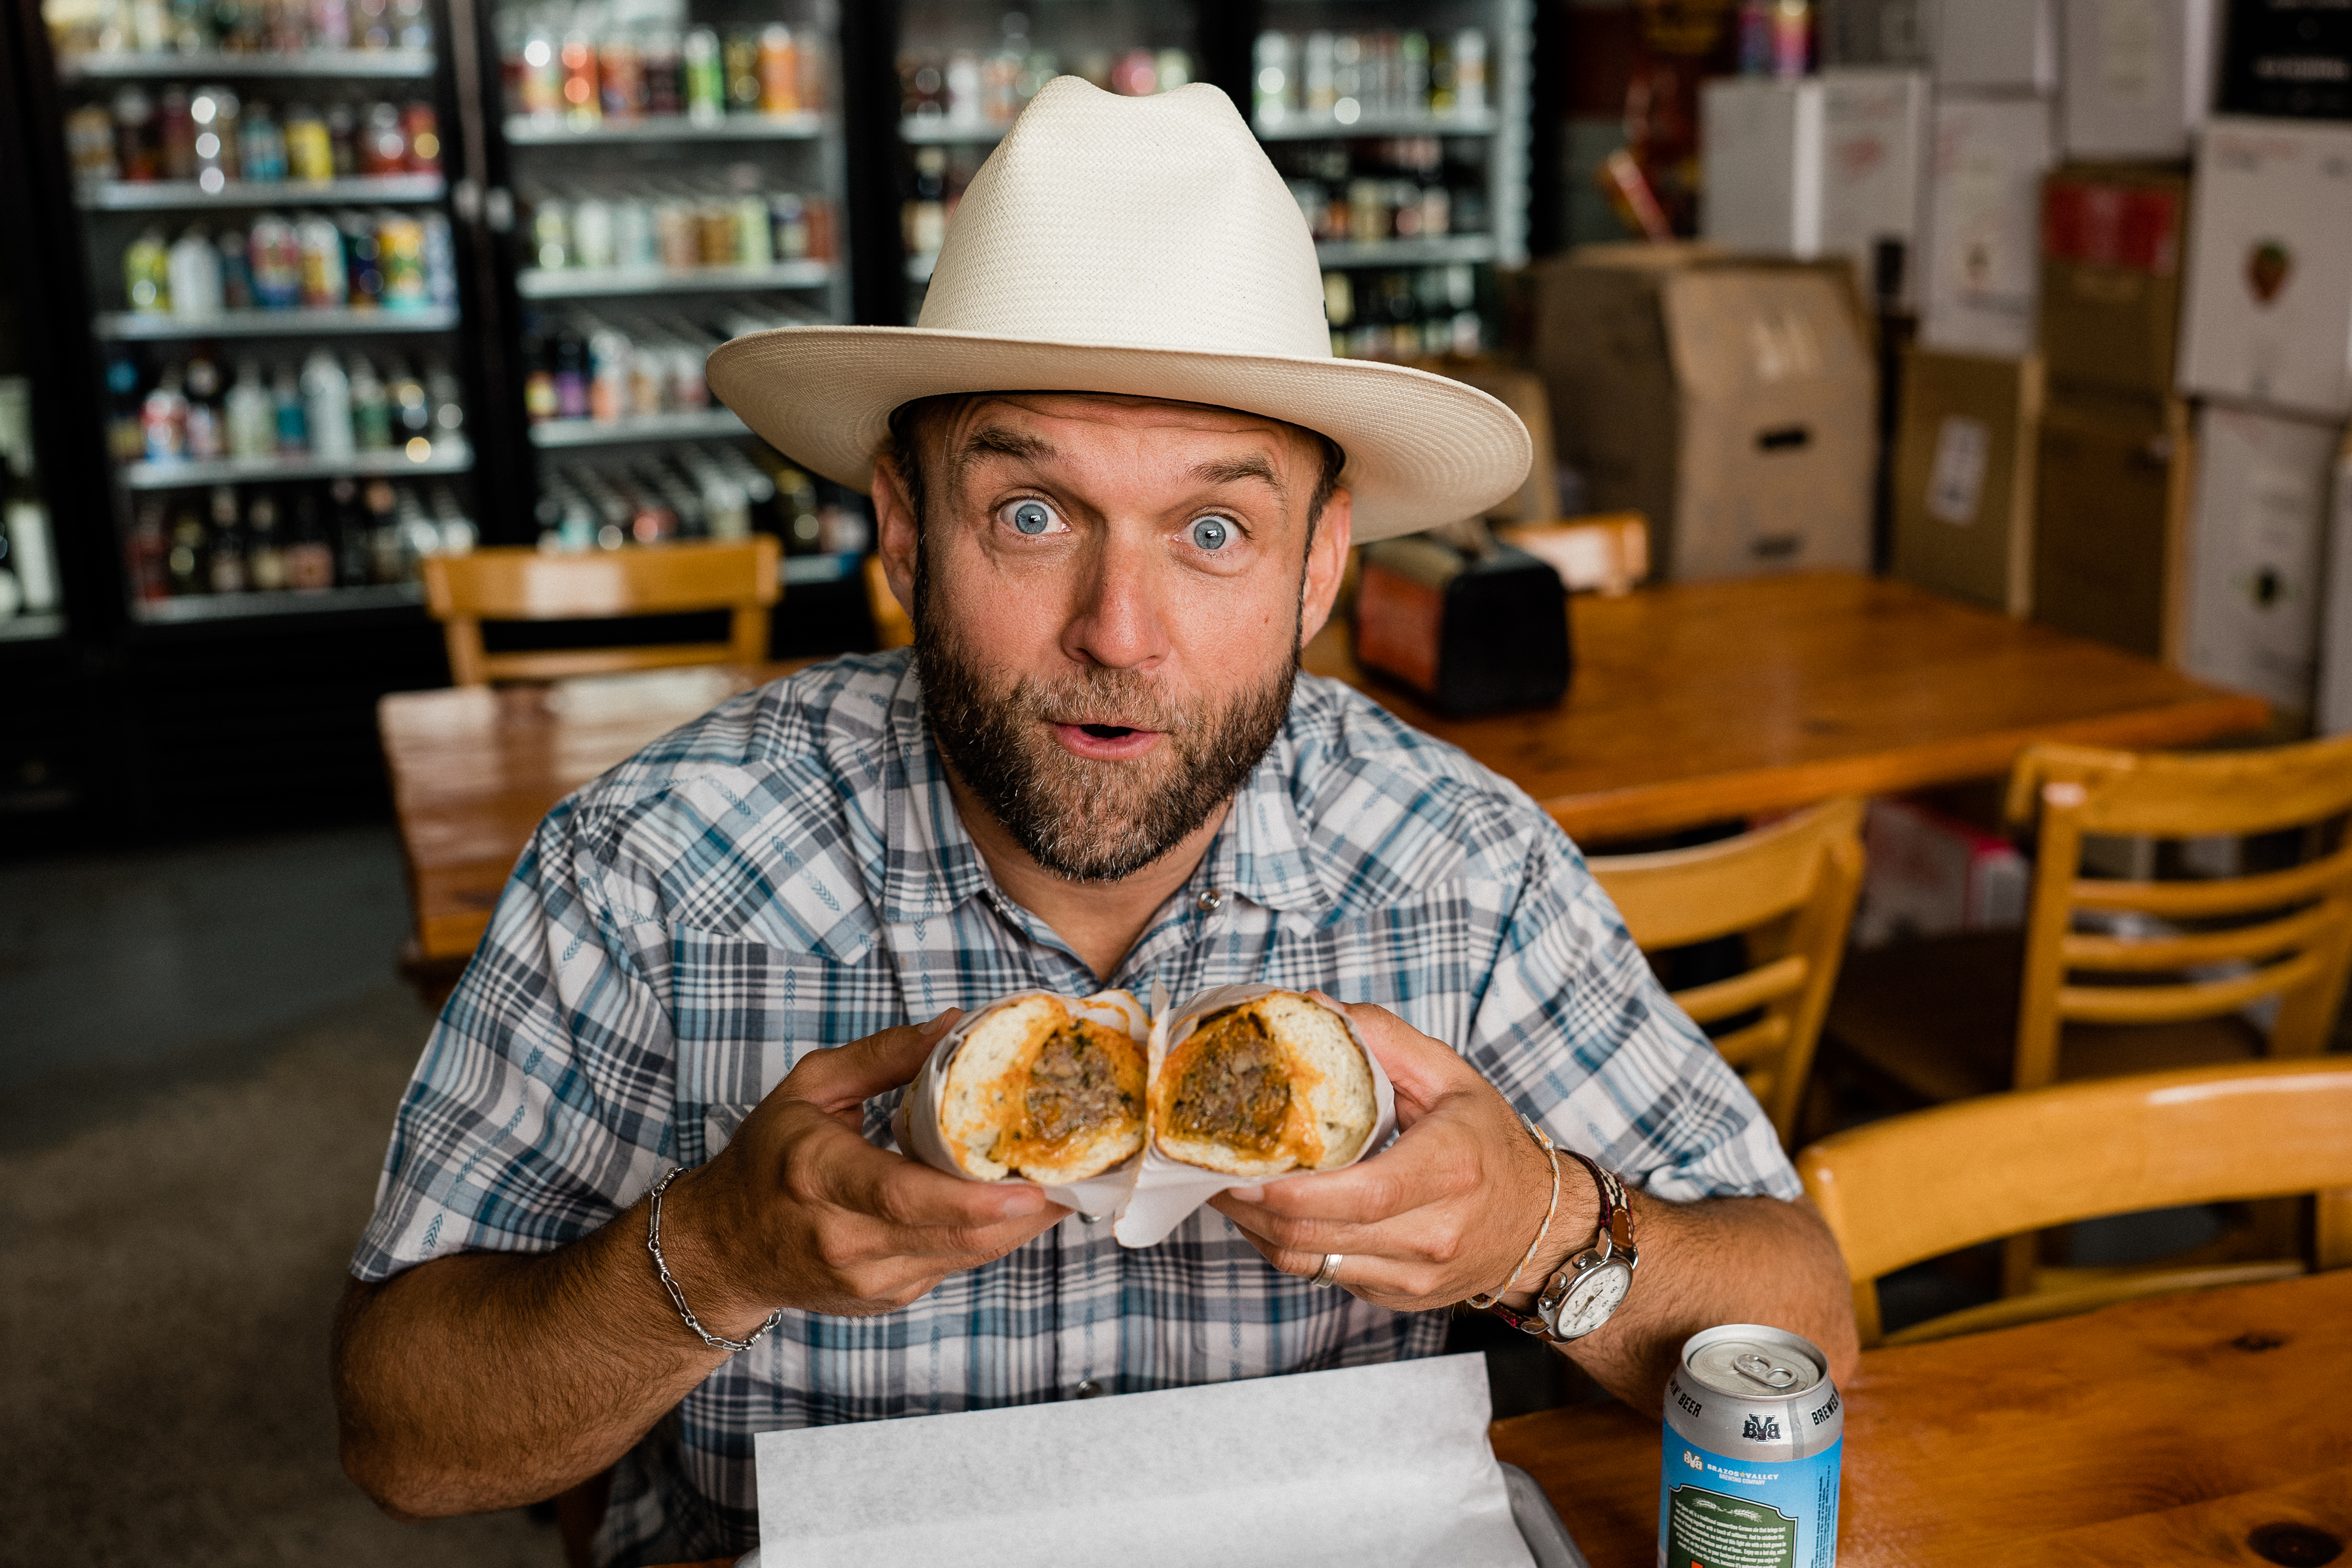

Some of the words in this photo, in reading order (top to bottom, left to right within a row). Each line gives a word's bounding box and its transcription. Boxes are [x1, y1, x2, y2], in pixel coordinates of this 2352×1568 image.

[1678, 1392, 1702, 1418] BEER
[1811, 1393, 1838, 1426] BREWED
[1707, 1464, 1739, 1477] BRAZOS
[1719, 1473, 1741, 1483] BREWING
[1693, 1519, 1706, 1528] together
[1700, 1515, 1716, 1524] traditional
